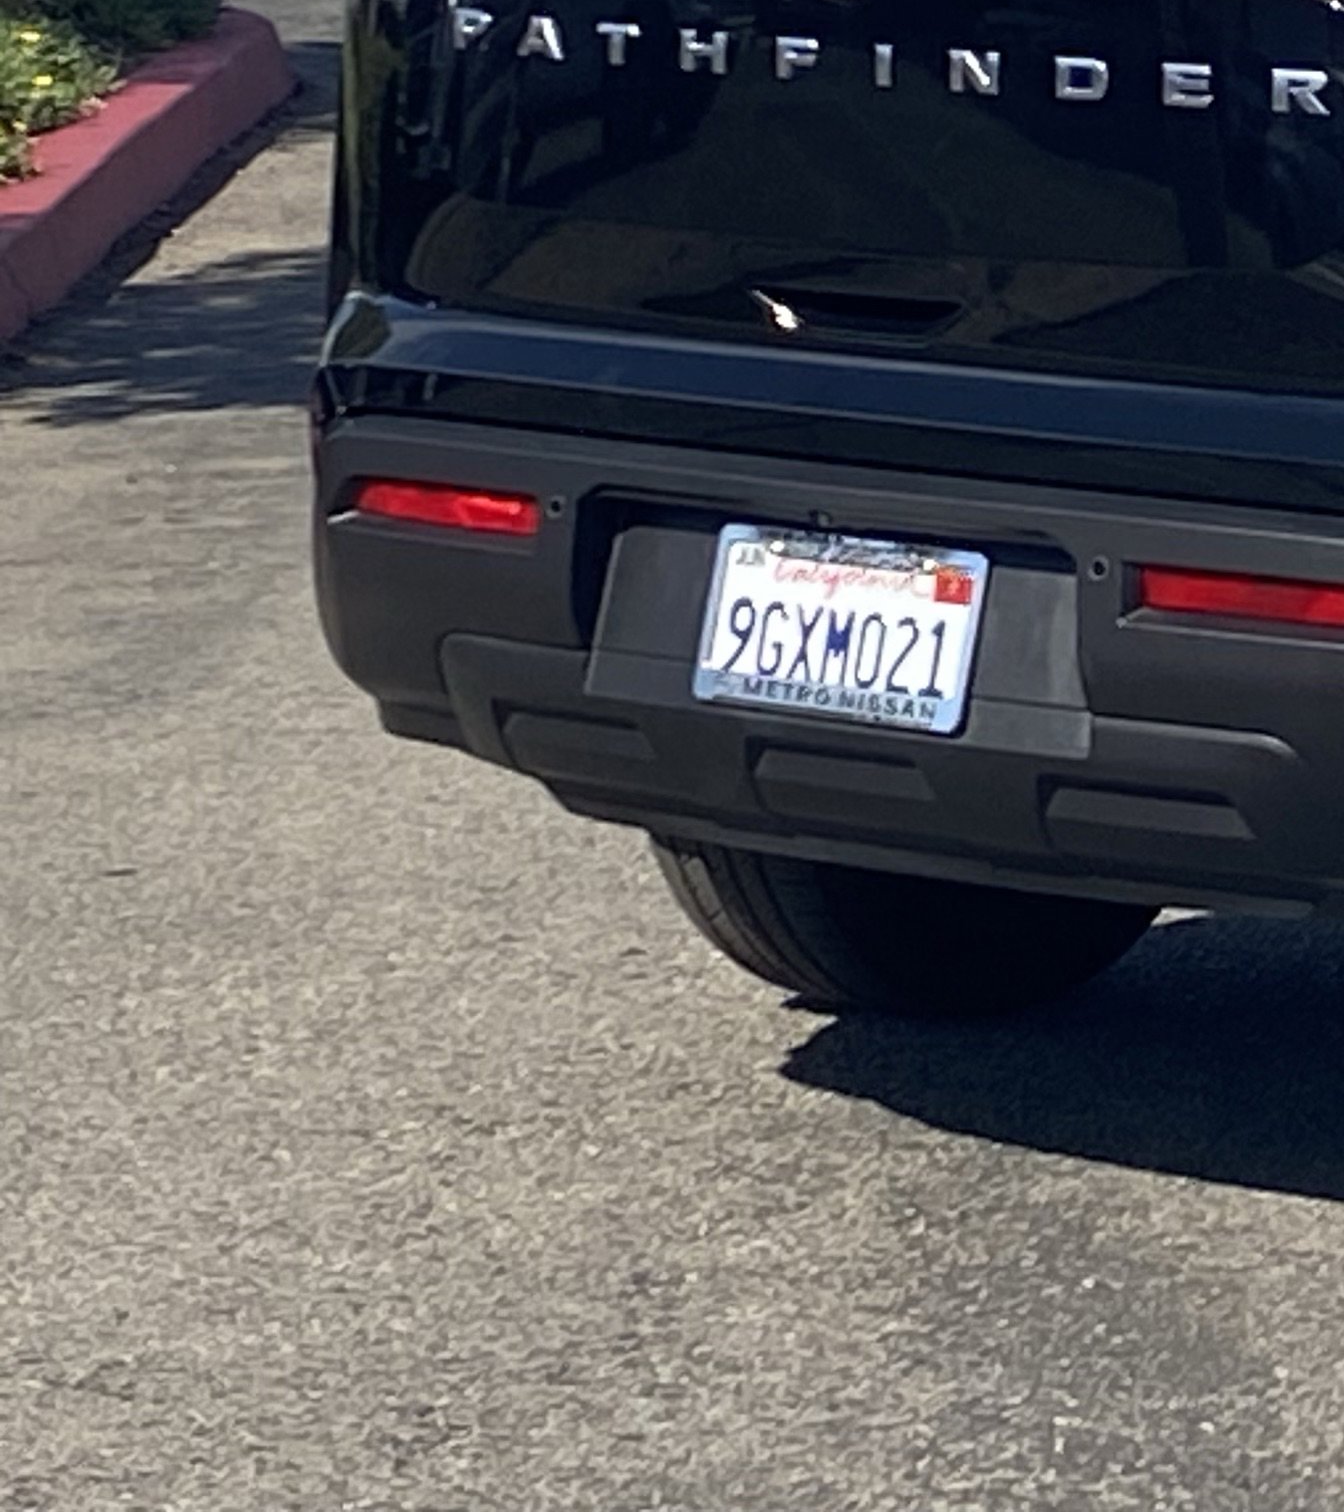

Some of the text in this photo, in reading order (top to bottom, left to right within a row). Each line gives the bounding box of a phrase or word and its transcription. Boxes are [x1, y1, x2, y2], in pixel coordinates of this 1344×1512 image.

[452, 6, 1331, 117] PATHFINDER
[722, 596, 946, 699] 9GXM021
[743, 678, 937, 719] METRO NISSAN
